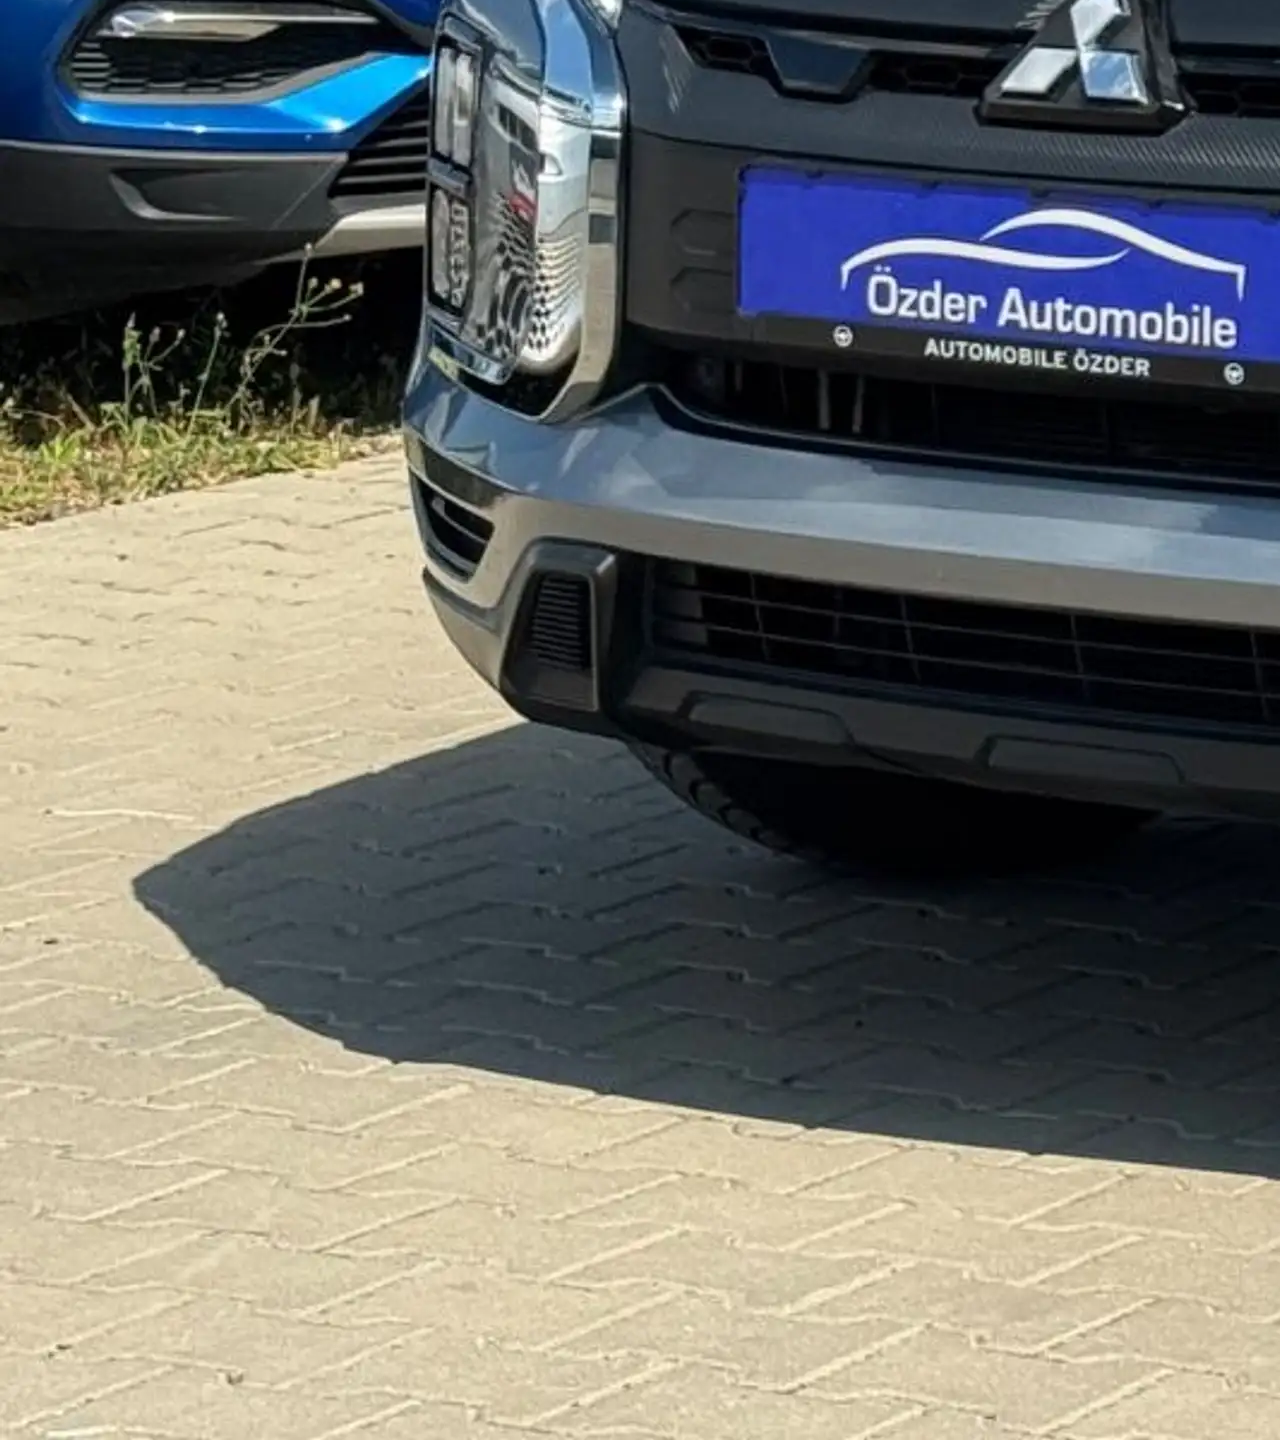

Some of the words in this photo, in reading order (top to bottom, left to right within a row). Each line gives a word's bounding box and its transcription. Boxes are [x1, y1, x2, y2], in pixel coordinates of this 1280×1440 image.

[867, 264, 988, 324] Özder
[997, 287, 1238, 349] Automobile
[923, 337, 1067, 371] AUTOMOBILE
[1073, 348, 1151, 377] ÖZDER
